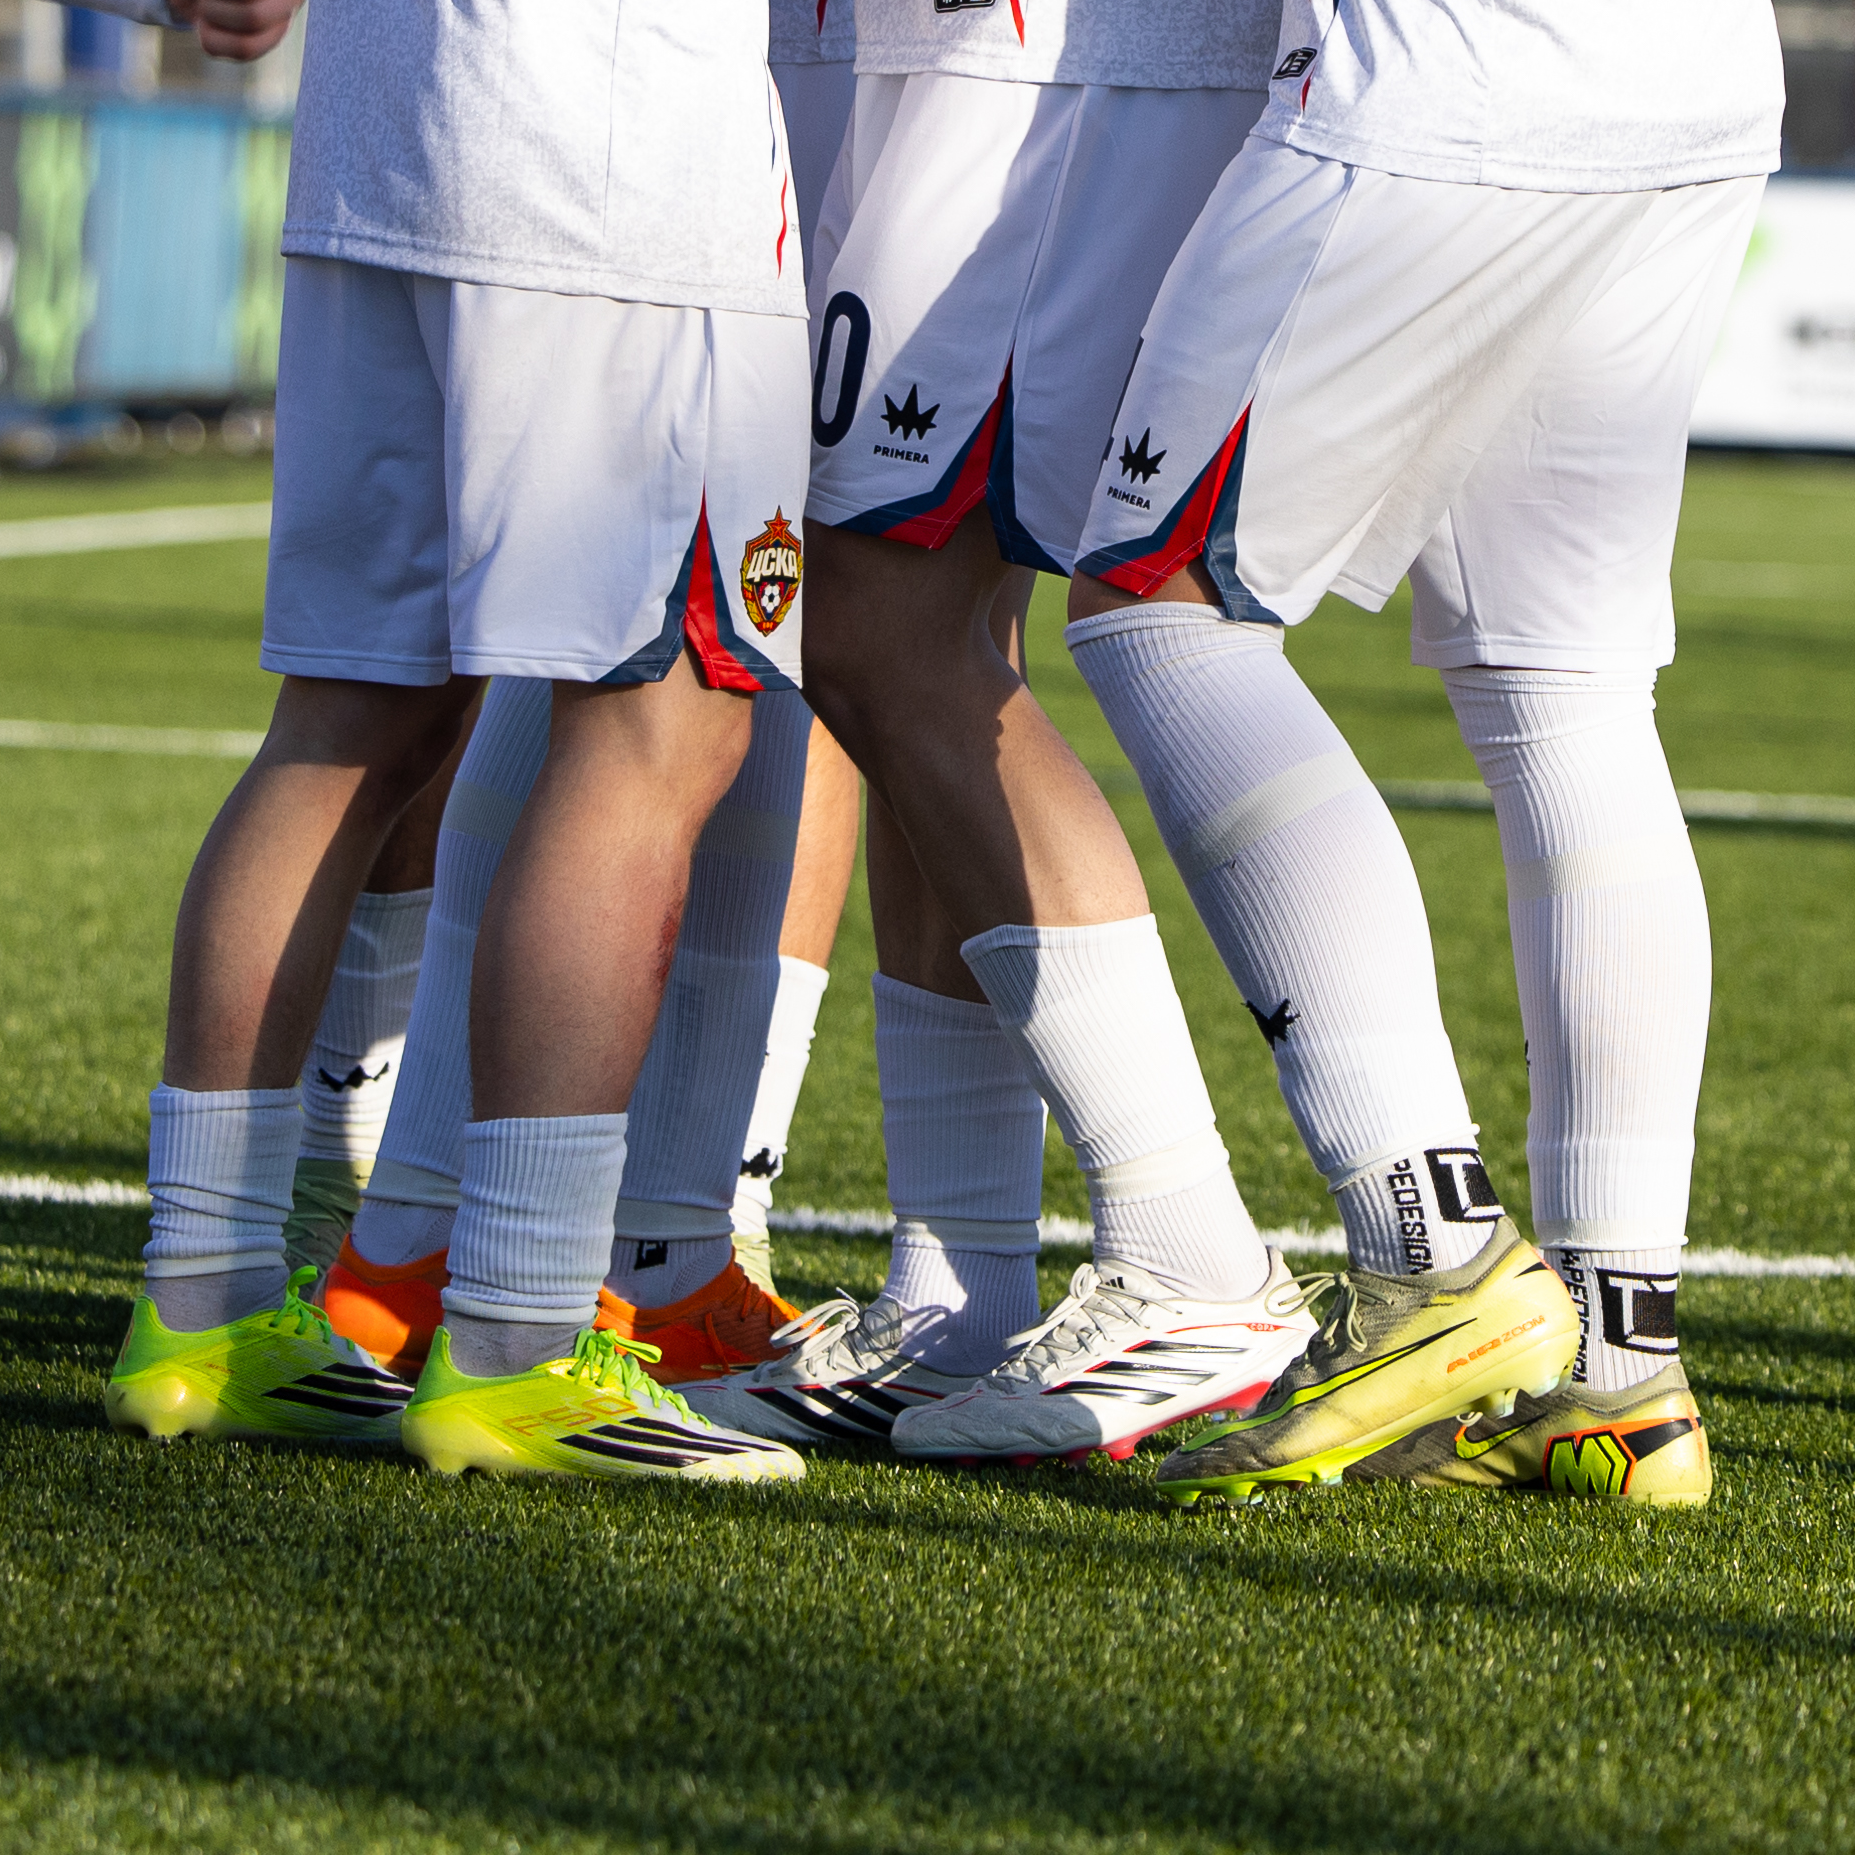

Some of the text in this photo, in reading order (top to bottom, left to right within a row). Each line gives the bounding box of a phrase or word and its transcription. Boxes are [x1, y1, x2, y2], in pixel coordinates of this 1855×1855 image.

[873, 444, 930, 465] PRIMERA
[1106, 485, 1151, 510] PRIMERA
[745, 547, 798, 583] ЦСКА
[1501, 1314, 1546, 1343] ZOOM
